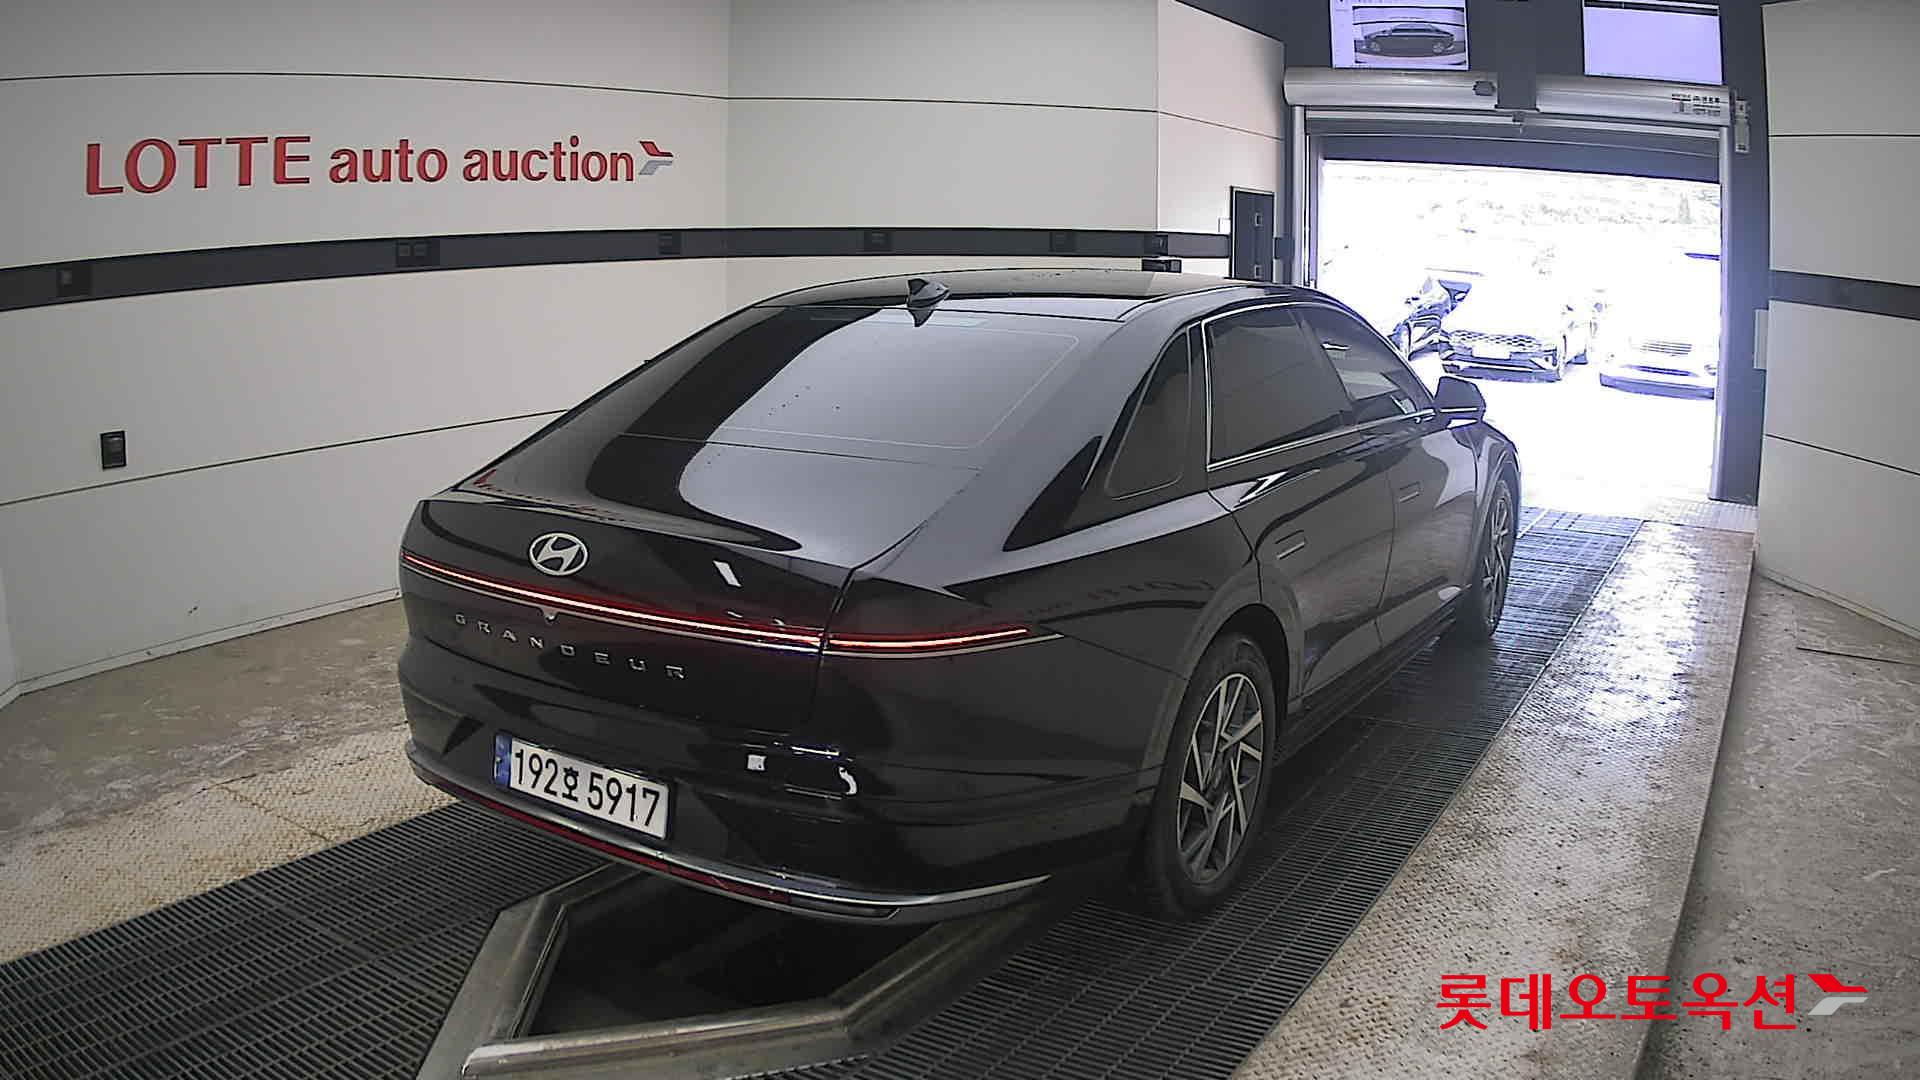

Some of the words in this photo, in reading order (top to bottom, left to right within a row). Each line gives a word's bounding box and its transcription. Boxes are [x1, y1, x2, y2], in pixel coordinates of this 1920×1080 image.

[85, 135, 311, 195] LOTTE
[329, 139, 448, 183] auto
[463, 135, 635, 182] auction
[455, 613, 685, 679] GRANDEUR
